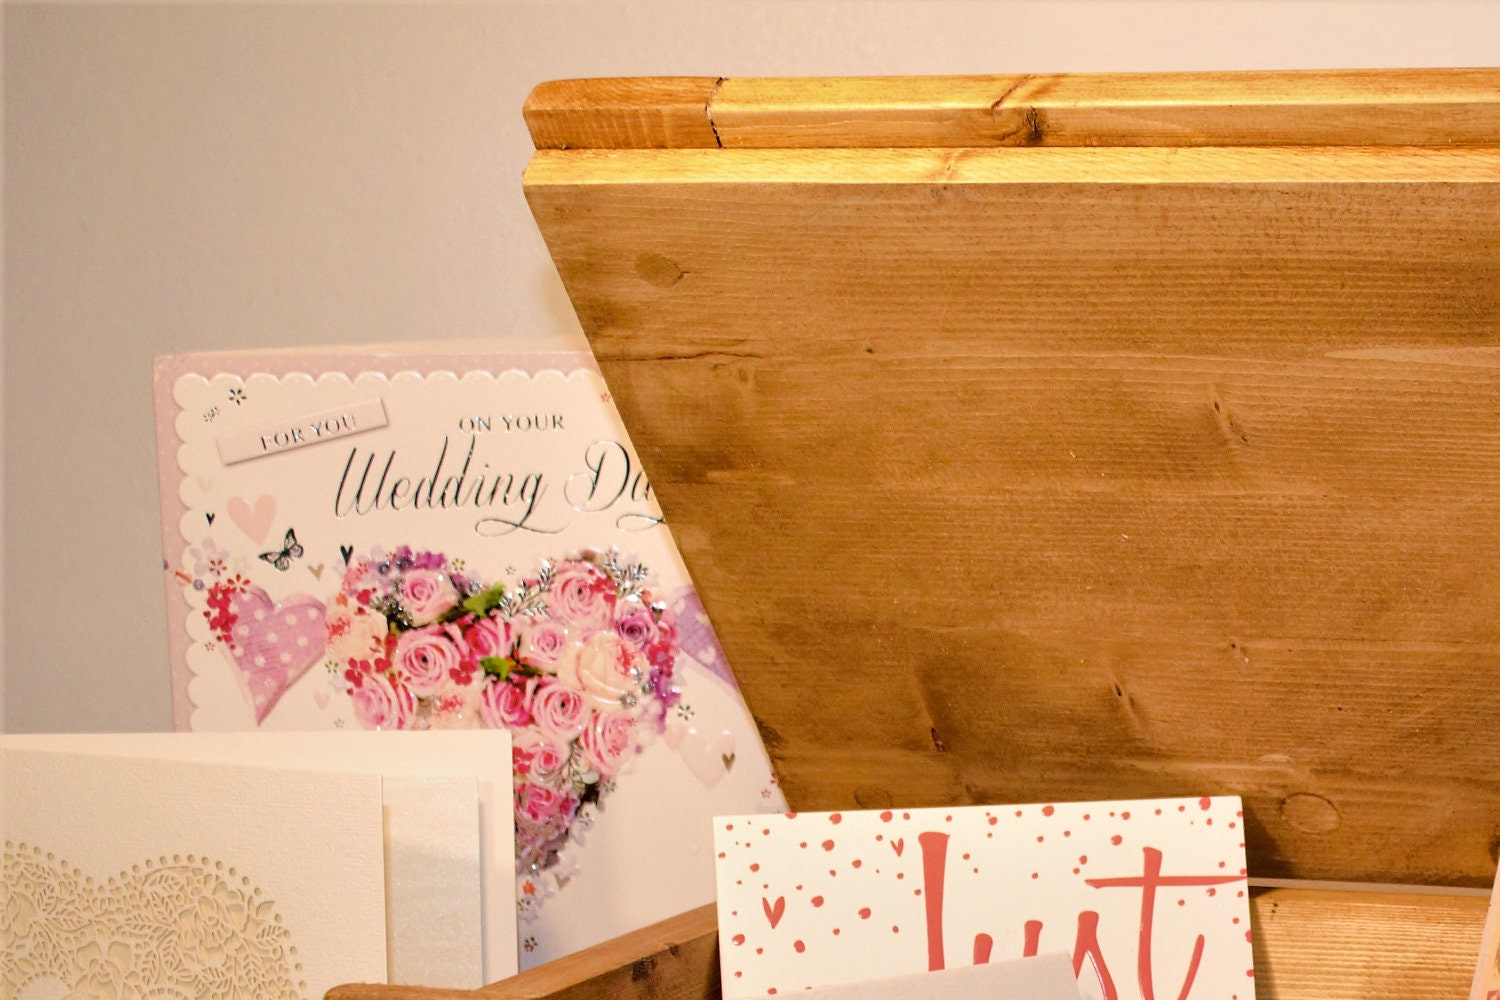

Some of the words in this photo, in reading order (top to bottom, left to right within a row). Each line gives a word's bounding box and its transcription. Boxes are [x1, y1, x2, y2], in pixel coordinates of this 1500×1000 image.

[259, 426, 306, 452] FOR
[309, 412, 358, 438] YOU
[459, 415, 492, 434] ON
[501, 414, 564, 432] YOUR
[335, 434, 570, 537] Wedding
[563, 439, 665, 532] Da
